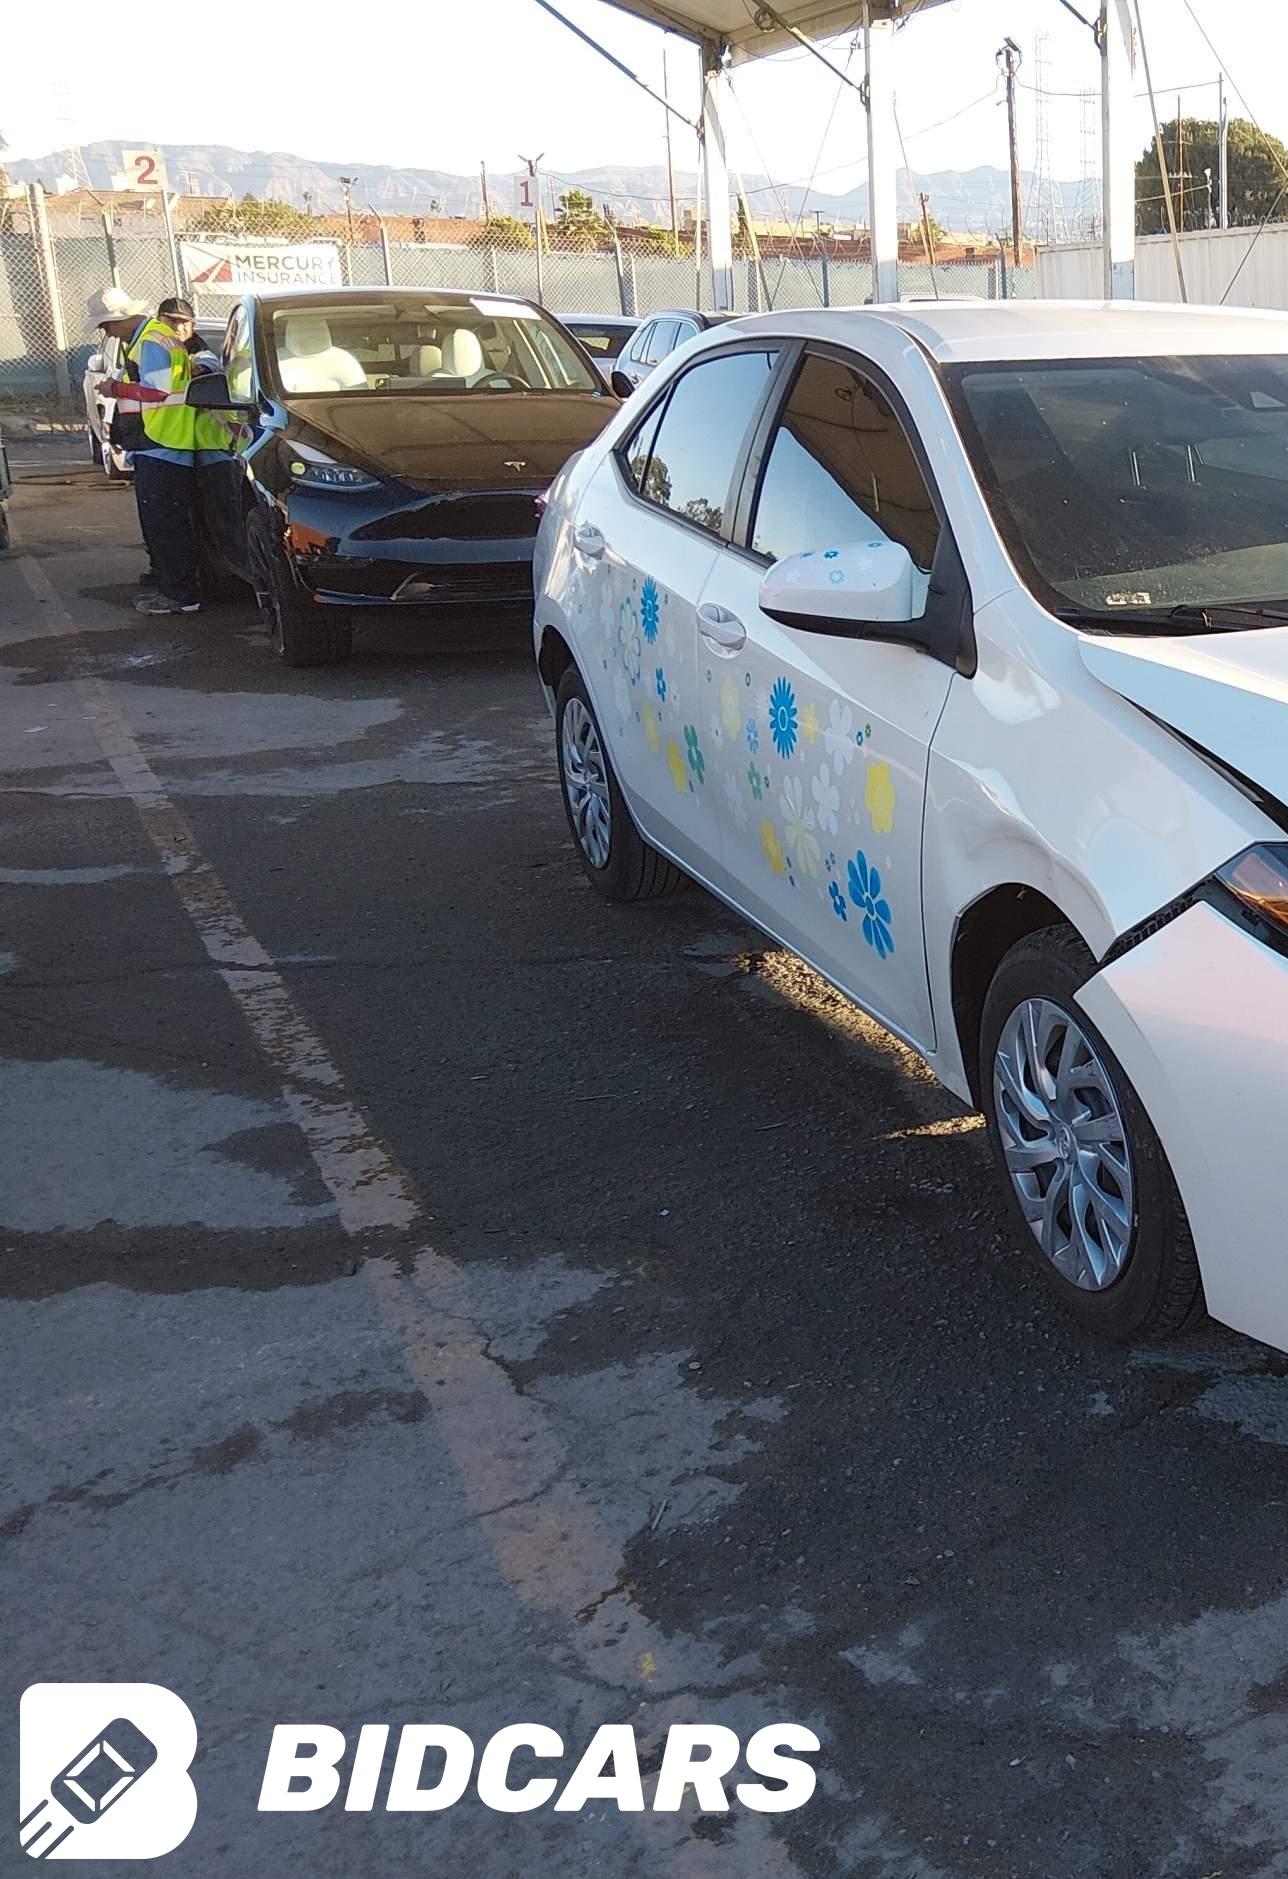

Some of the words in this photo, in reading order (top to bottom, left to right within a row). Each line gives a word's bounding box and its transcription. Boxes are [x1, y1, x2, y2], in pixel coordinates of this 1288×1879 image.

[134, 155, 159, 185] 2
[519, 180, 534, 207] 1
[234, 254, 336, 270] MERCURY
[237, 271, 338, 285] INSURANCE
